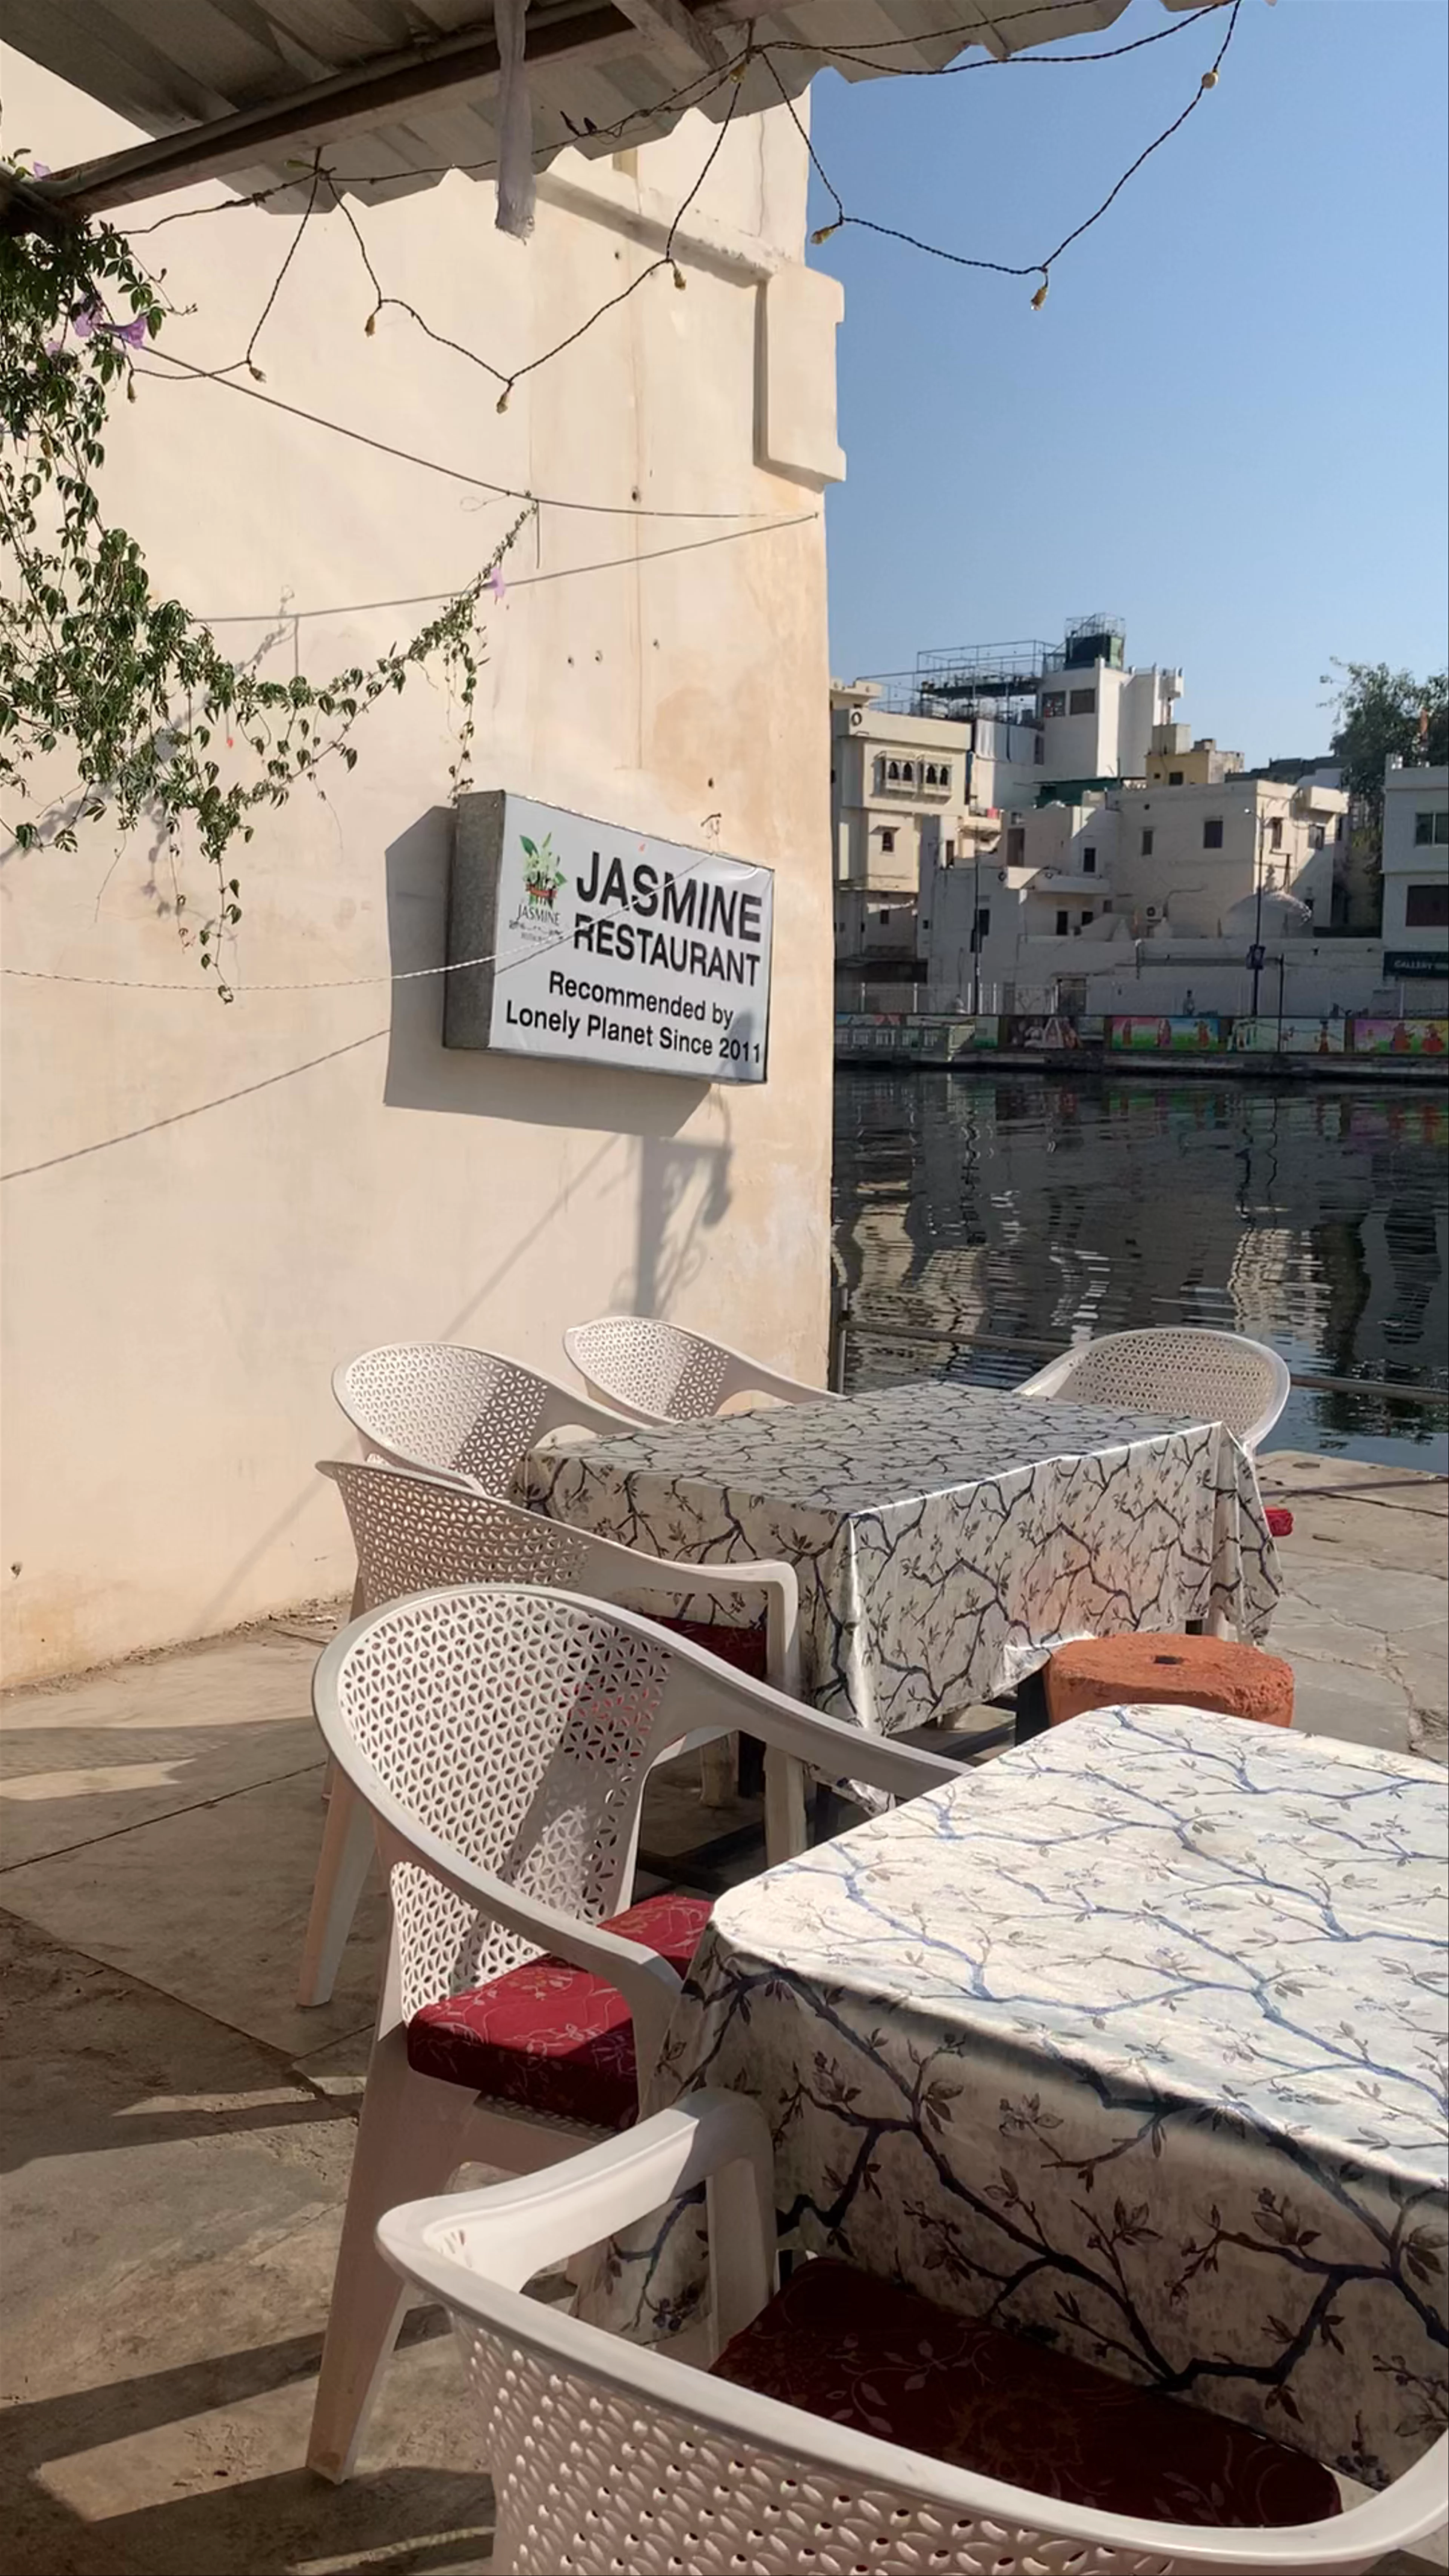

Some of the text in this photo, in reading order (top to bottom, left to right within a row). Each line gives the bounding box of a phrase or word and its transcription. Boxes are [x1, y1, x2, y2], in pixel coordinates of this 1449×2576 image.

[517, 904, 560, 926] JASMINE
[577, 851, 762, 943] JASMINE
[574, 912, 761, 986] RESTAURANT
[506, 1000, 760, 1063] Lonely Planet Since 2011
[549, 970, 734, 1030] Recommended by
